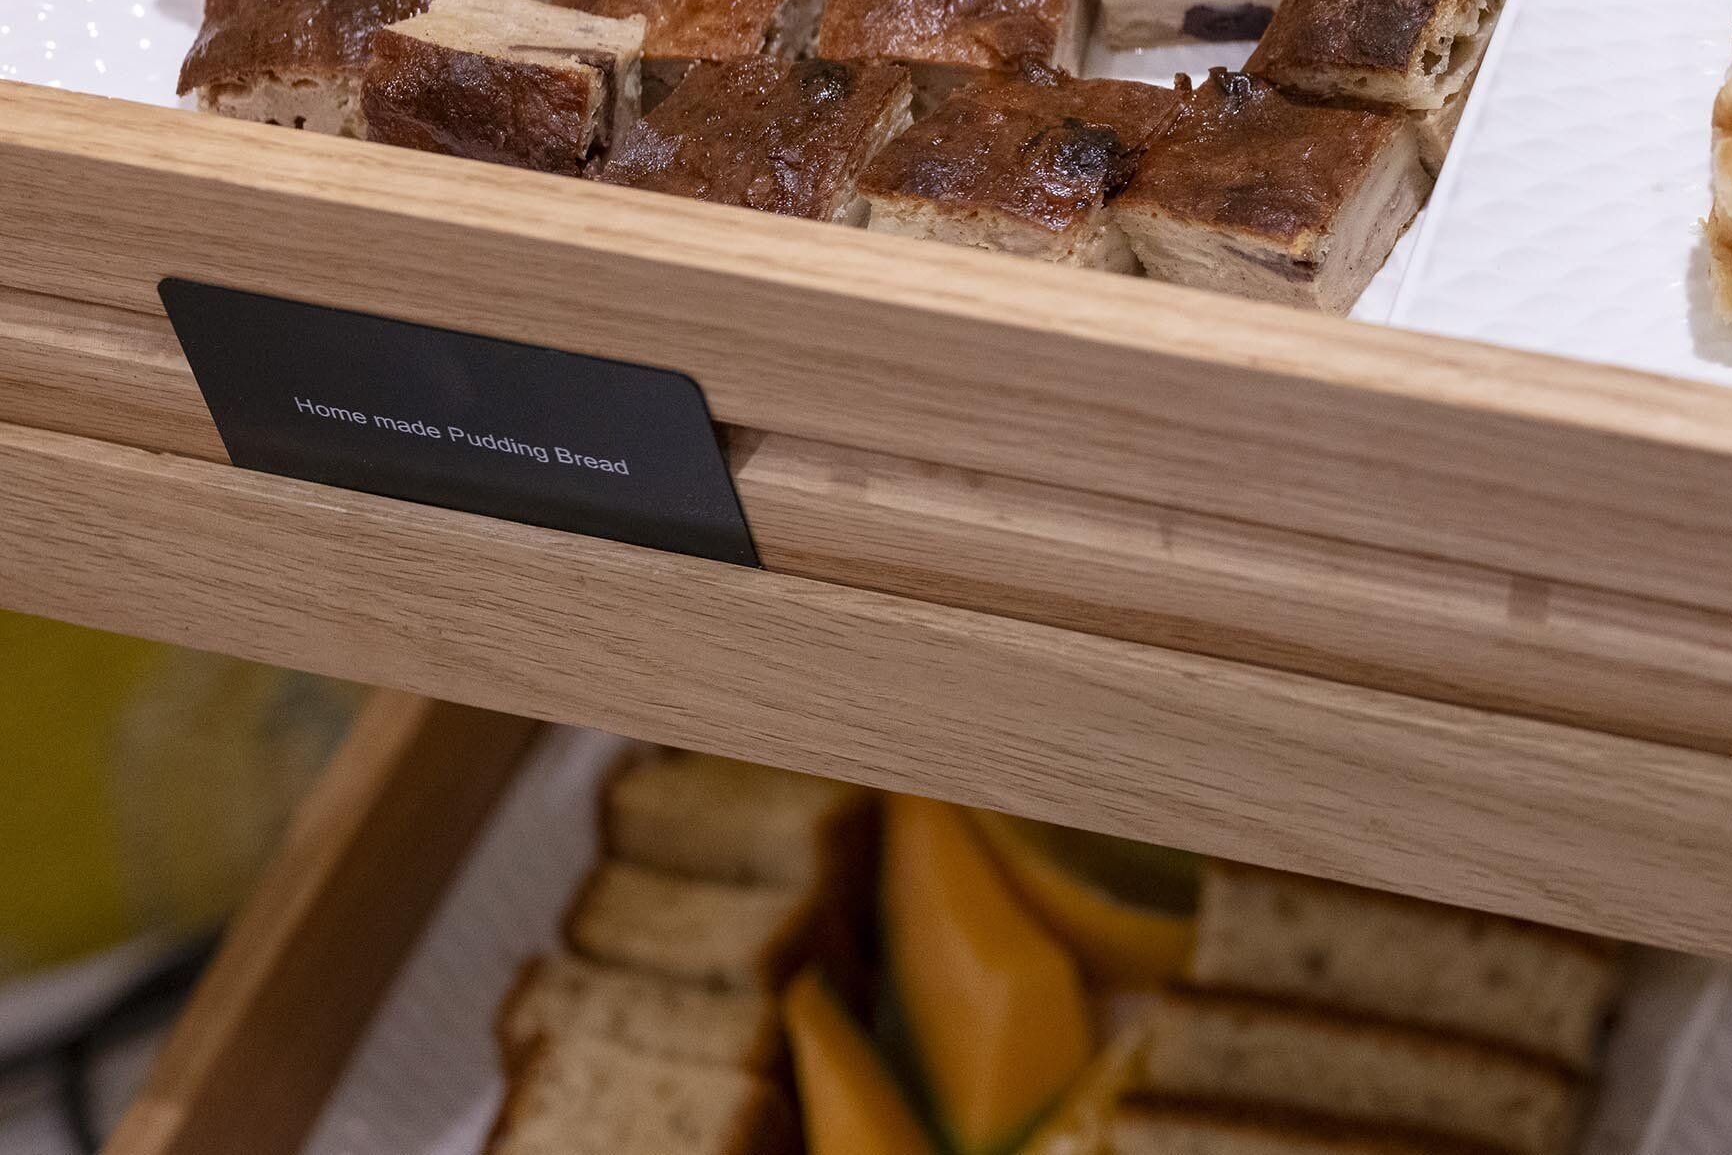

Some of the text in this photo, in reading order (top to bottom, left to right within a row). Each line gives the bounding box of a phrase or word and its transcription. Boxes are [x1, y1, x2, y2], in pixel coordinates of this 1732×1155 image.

[294, 396, 631, 476] Home made Pudding Bread
